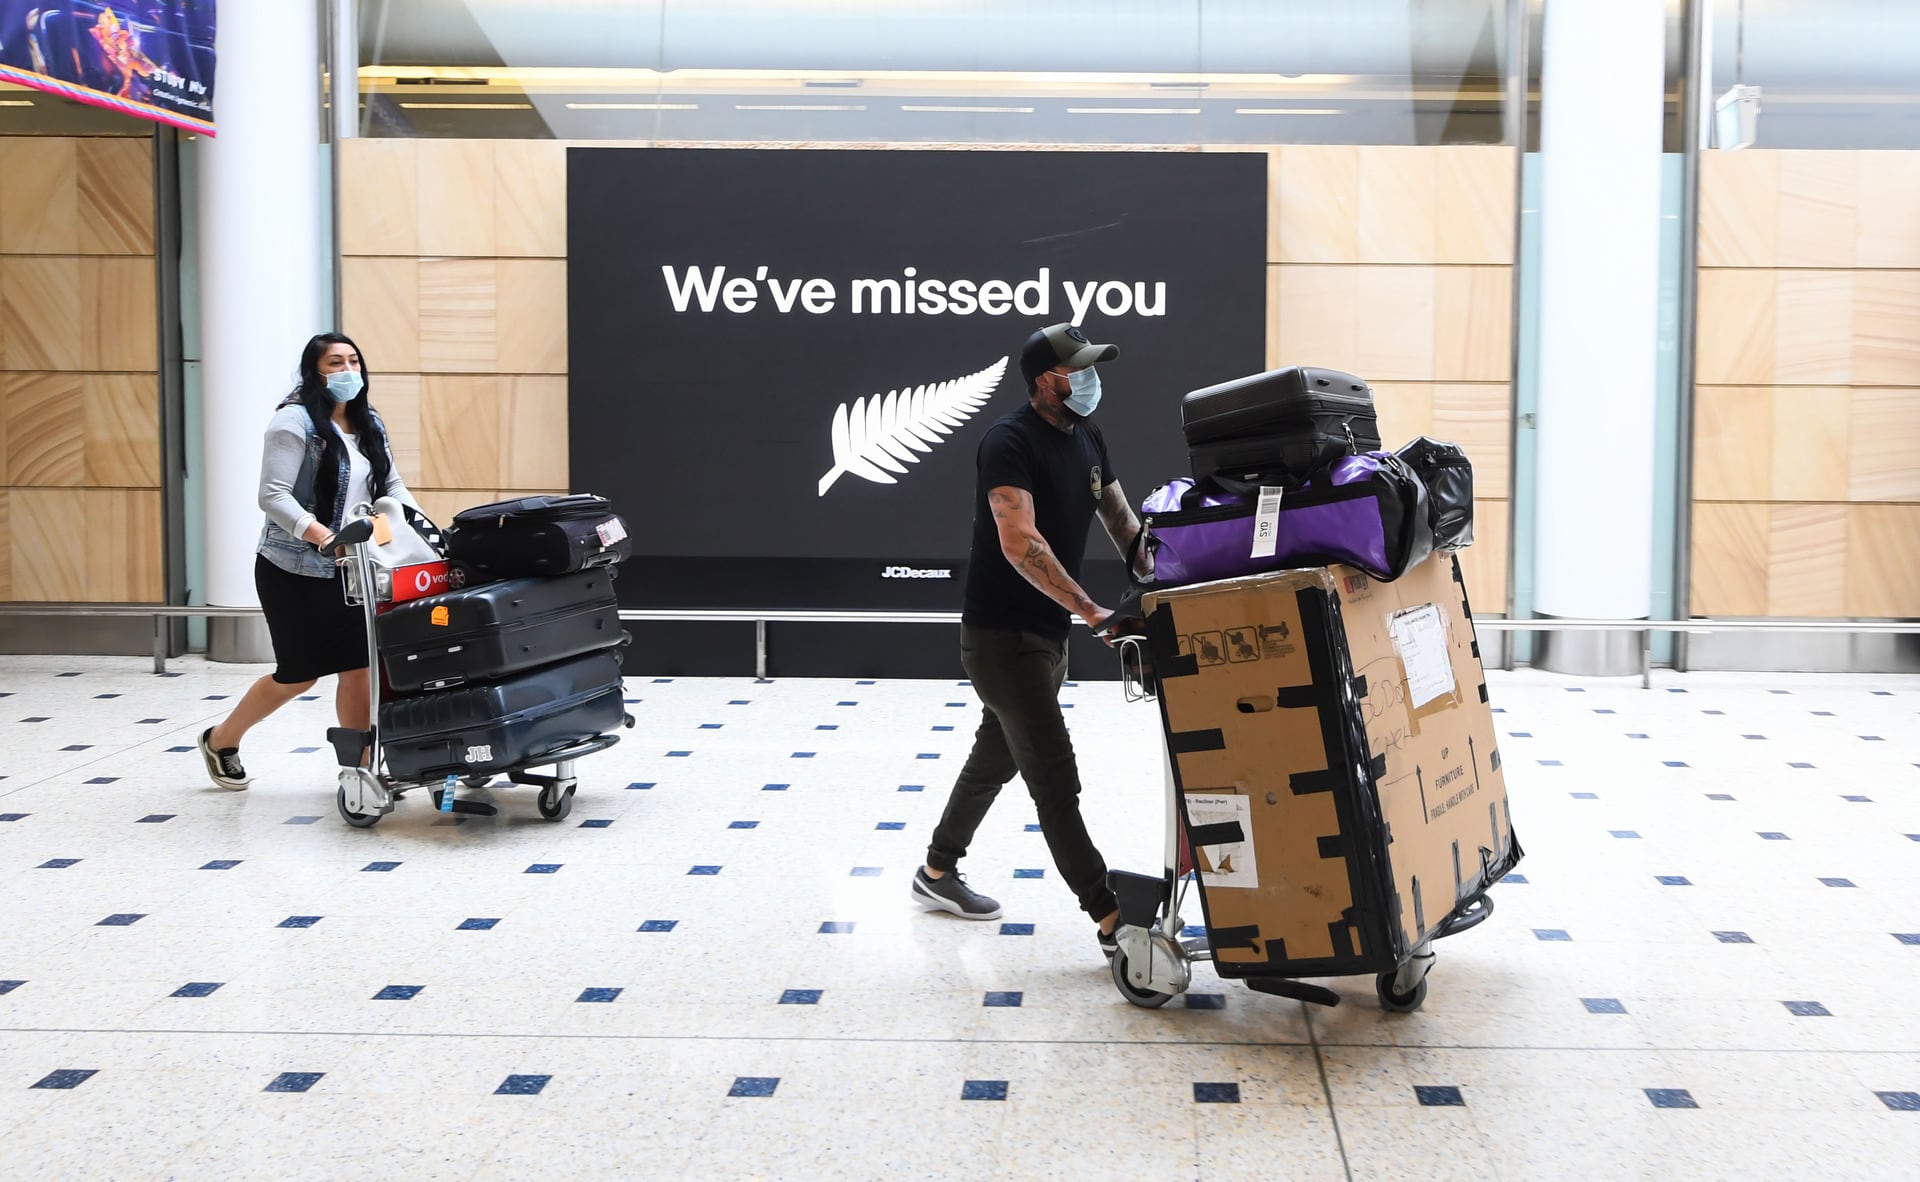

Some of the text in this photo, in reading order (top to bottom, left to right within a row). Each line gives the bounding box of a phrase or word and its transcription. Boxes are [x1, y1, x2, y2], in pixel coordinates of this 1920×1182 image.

[661, 265, 1167, 328] We've missed you
[1259, 521, 1269, 538] SYD
[432, 570, 449, 584] vod
[881, 566, 952, 578] JCDecaux
[1441, 746, 1449, 760] UP
[1435, 765, 1464, 791] FURNITURE
